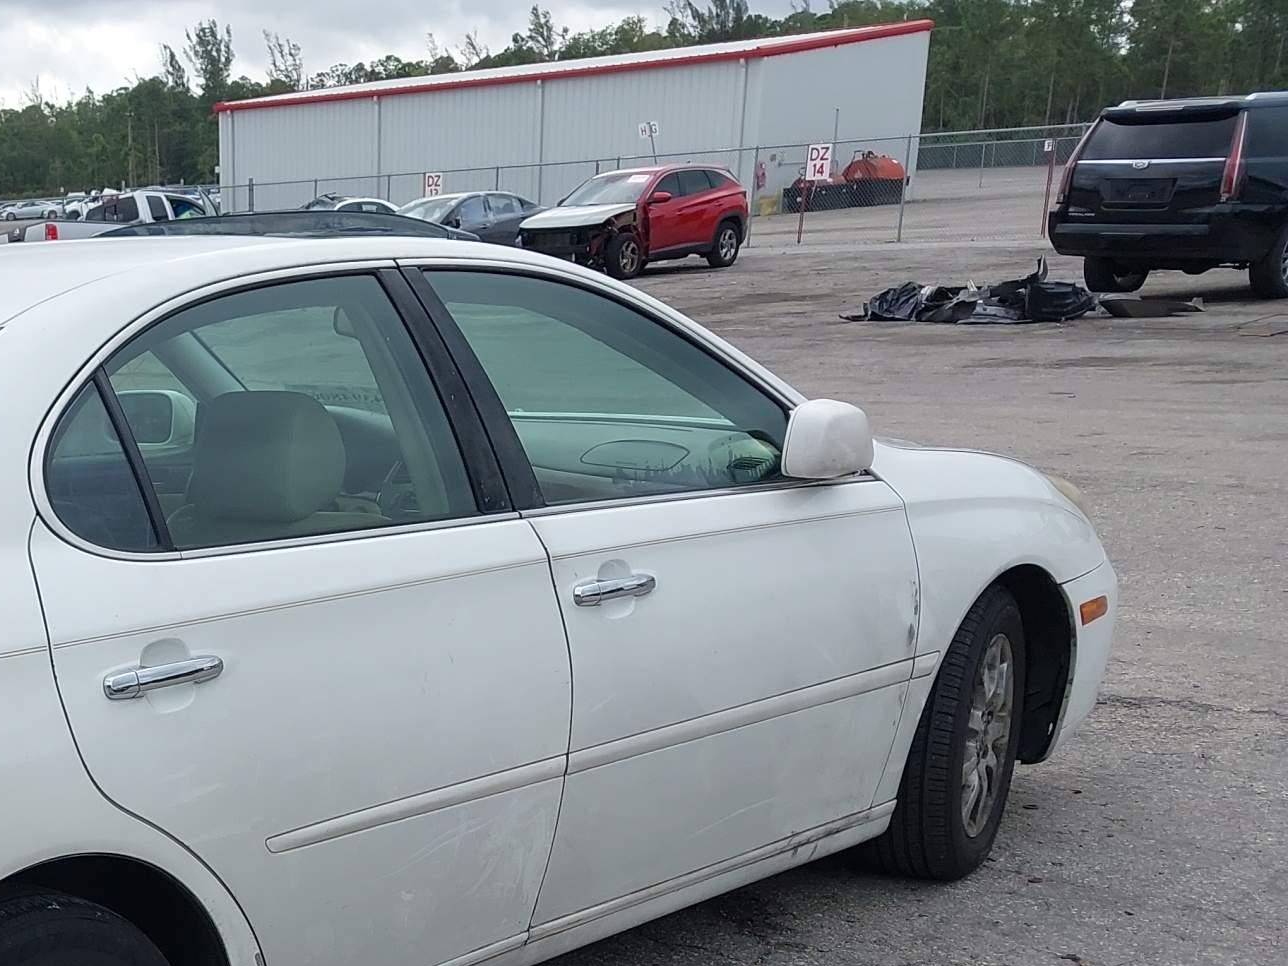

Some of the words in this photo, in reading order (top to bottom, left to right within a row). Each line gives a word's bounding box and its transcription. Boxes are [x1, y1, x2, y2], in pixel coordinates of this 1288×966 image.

[810, 146, 830, 161] DZ
[812, 162, 825, 177] 14
[427, 175, 441, 187] DZ
